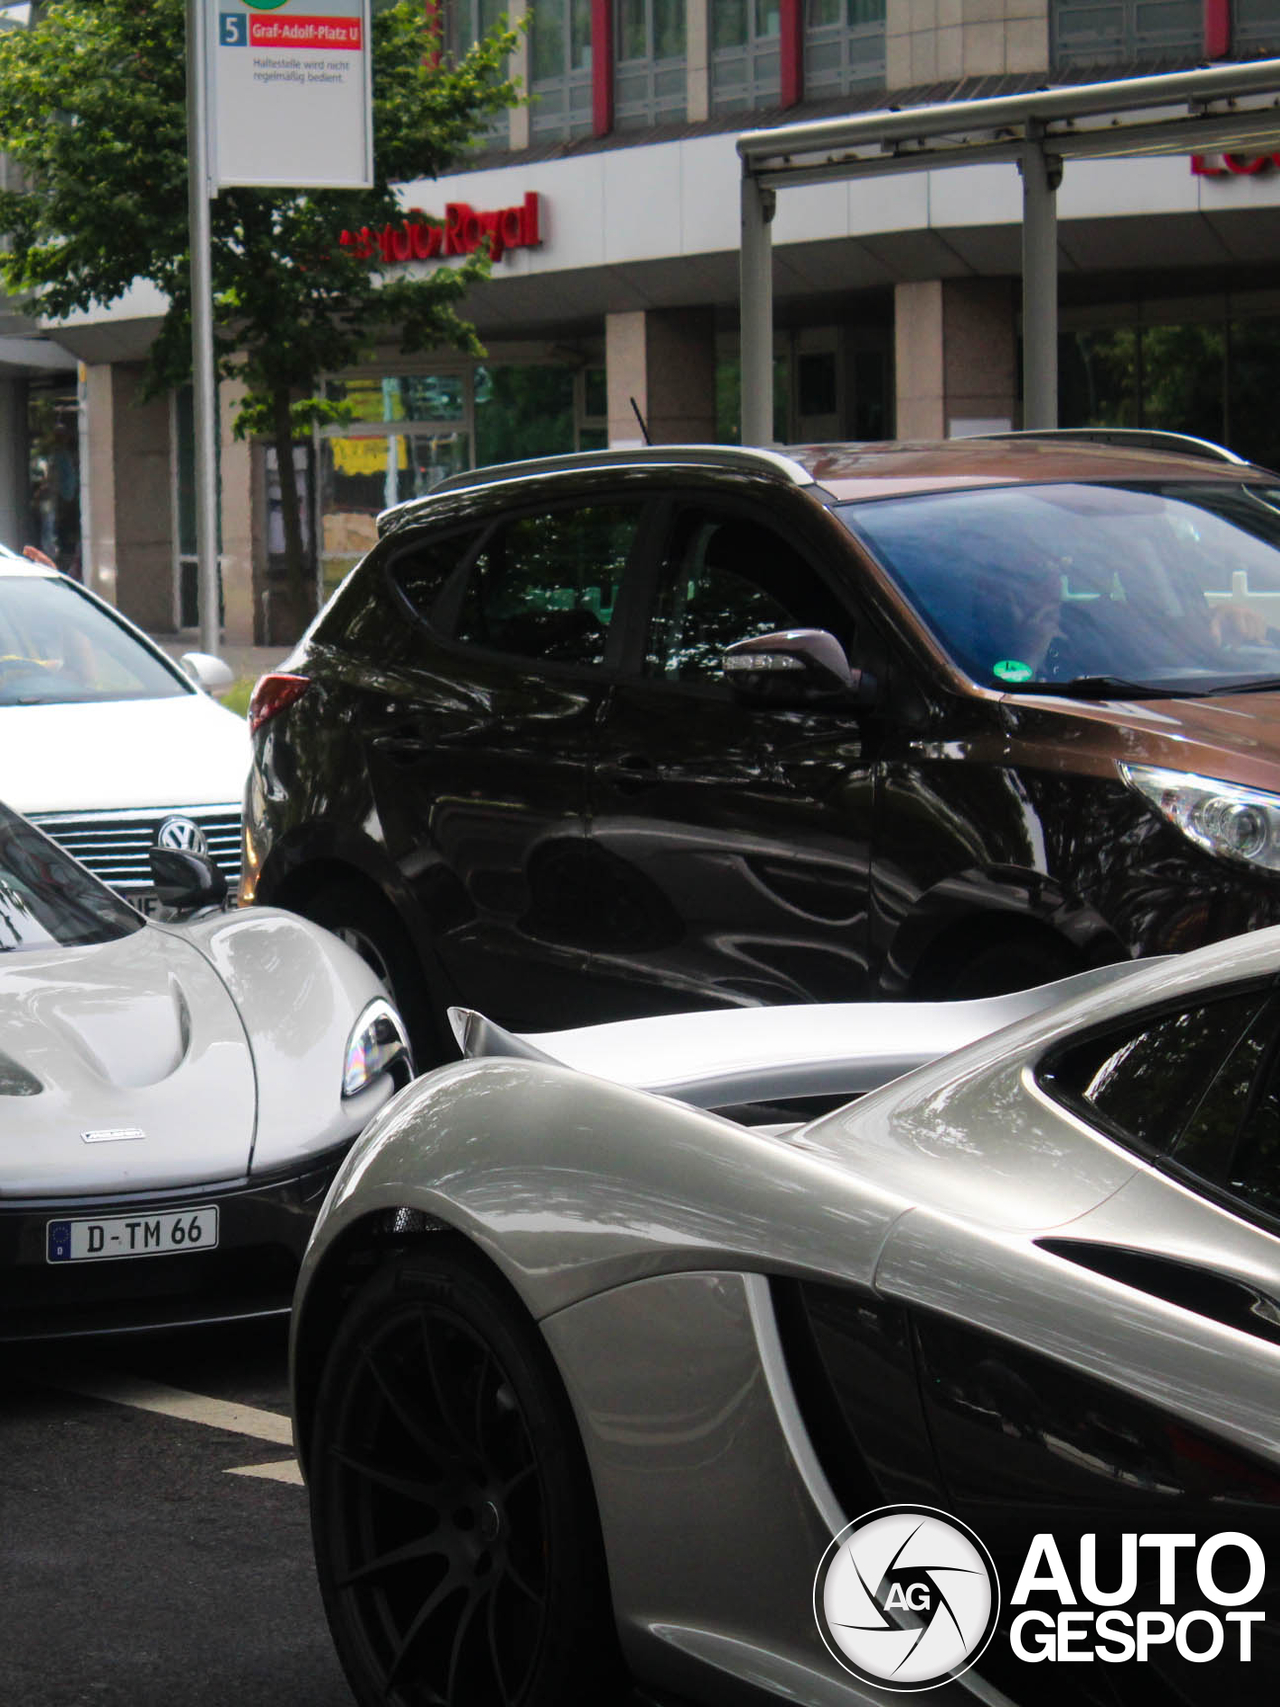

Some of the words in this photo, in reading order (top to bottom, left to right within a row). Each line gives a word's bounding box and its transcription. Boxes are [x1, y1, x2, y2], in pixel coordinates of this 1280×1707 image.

[225, 17, 239, 43] 5
[252, 23, 348, 41] Graf-Adolf-Platz
[349, 27, 359, 41] U
[253, 58, 302, 71] Haltestelle
[303, 59, 325, 72] wird
[326, 61, 350, 72] nicht
[253, 71, 306, 84] regelmäßig
[445, 191, 539, 263] Royal
[86, 1219, 161, 1253] D-TM
[170, 1215, 202, 1245] 66
